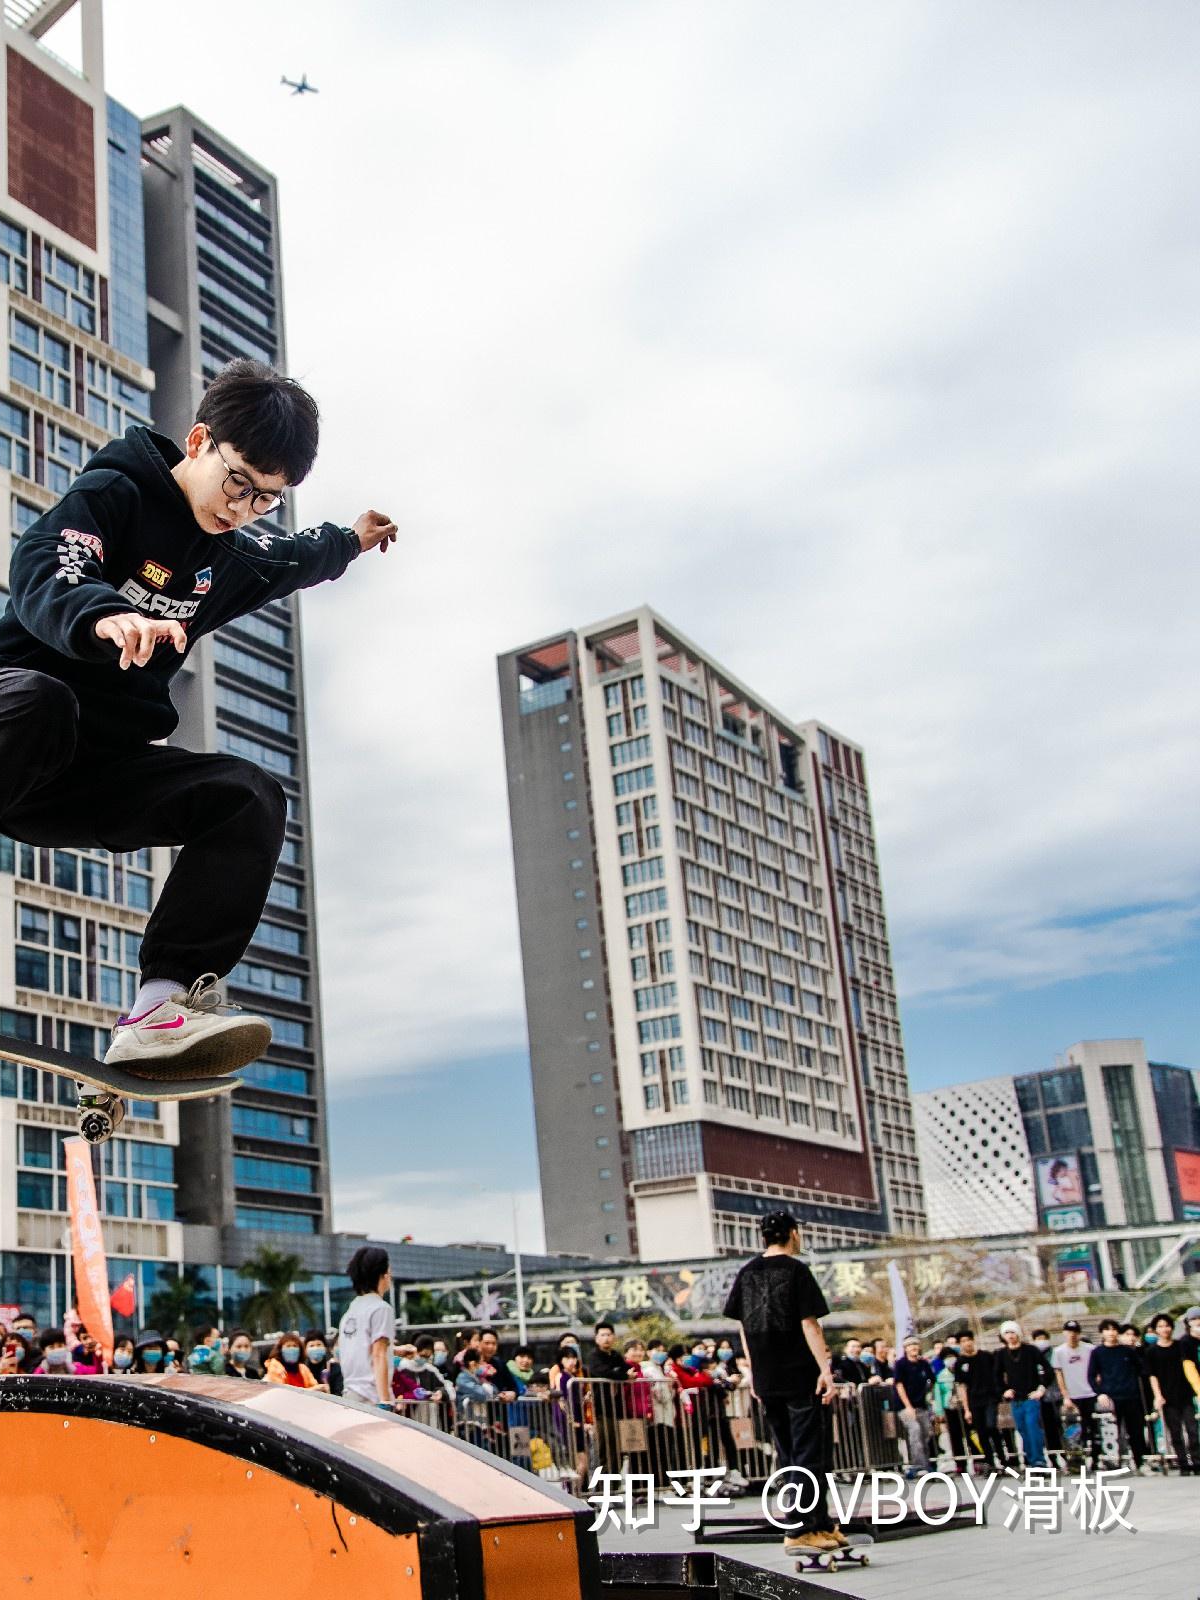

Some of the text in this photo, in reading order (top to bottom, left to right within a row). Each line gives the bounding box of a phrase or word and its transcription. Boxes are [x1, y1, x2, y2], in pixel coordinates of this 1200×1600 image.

[142, 563, 170, 586] DGK
[527, 1274, 653, 1315] 万千喜悦
